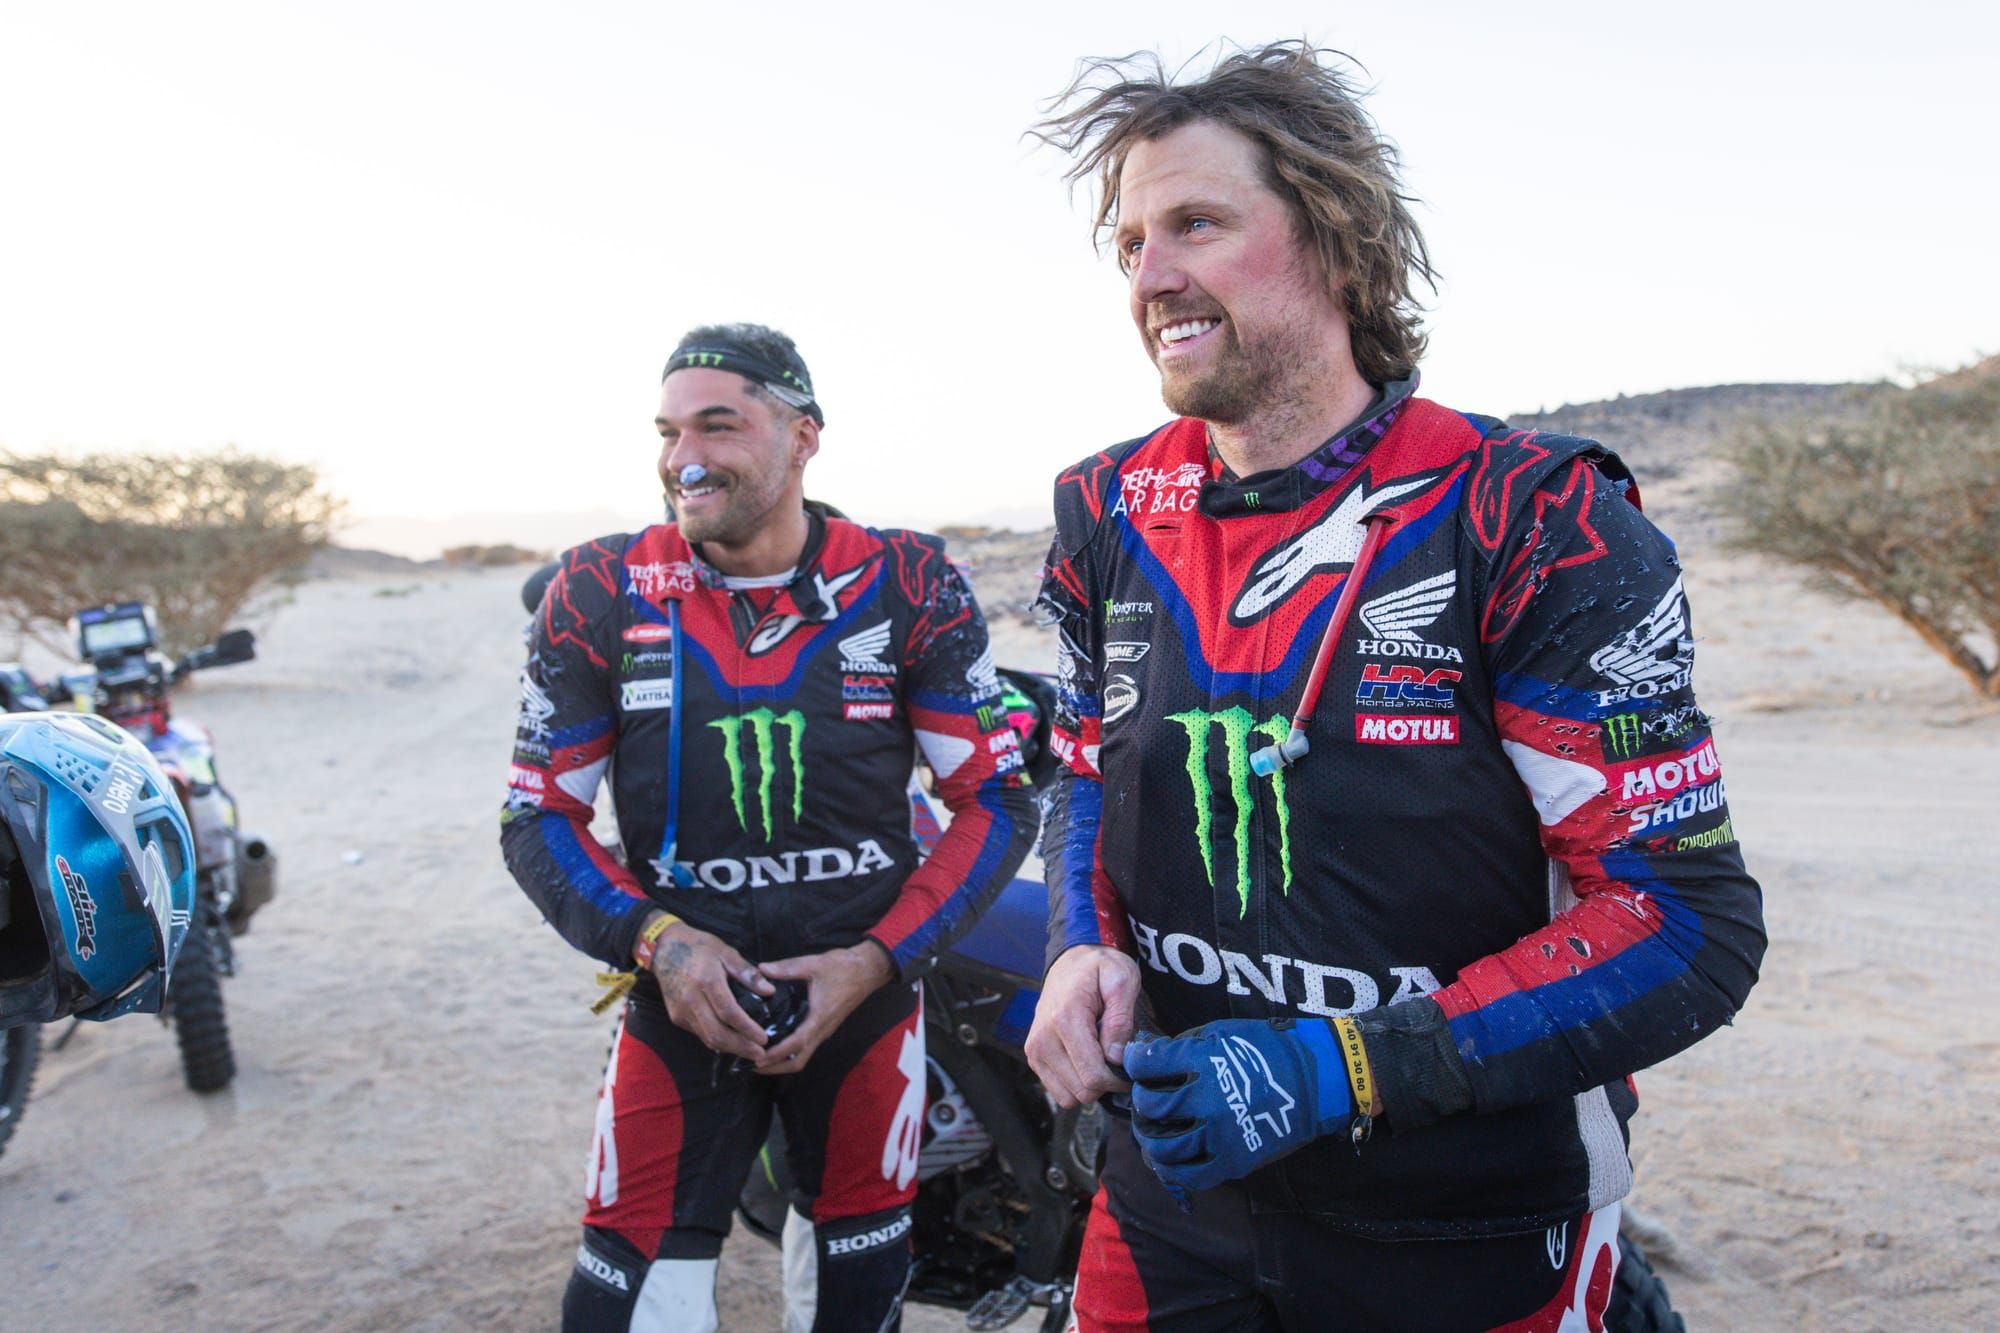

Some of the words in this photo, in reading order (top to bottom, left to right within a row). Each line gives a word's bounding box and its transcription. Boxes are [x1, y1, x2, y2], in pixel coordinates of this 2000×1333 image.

[1111, 492, 1146, 517] AR
[1150, 489, 1198, 514] BAG
[657, 575, 695, 593] BAG
[1356, 639, 1464, 663] HONDA
[840, 661, 898, 675] HONDA
[1355, 664, 1463, 701] HRC
[1597, 667, 1692, 707] HON
[635, 690, 672, 703] ARTISA
[1355, 699, 1404, 708] Honda
[1406, 700, 1455, 709] RACING
[1360, 718, 1455, 740] MOTUL
[1622, 743, 1719, 800] MOTU
[648, 839, 894, 892] HONDA
[1128, 913, 1445, 1017] HONDA
[1346, 1028, 1357, 1041] 40
[1350, 1043, 1360, 1057] 91
[1353, 1060, 1363, 1074] 30
[1356, 1077, 1366, 1092] 60
[1209, 1056, 1263, 1153] ASTARS
[577, 1245, 629, 1291] NDA
